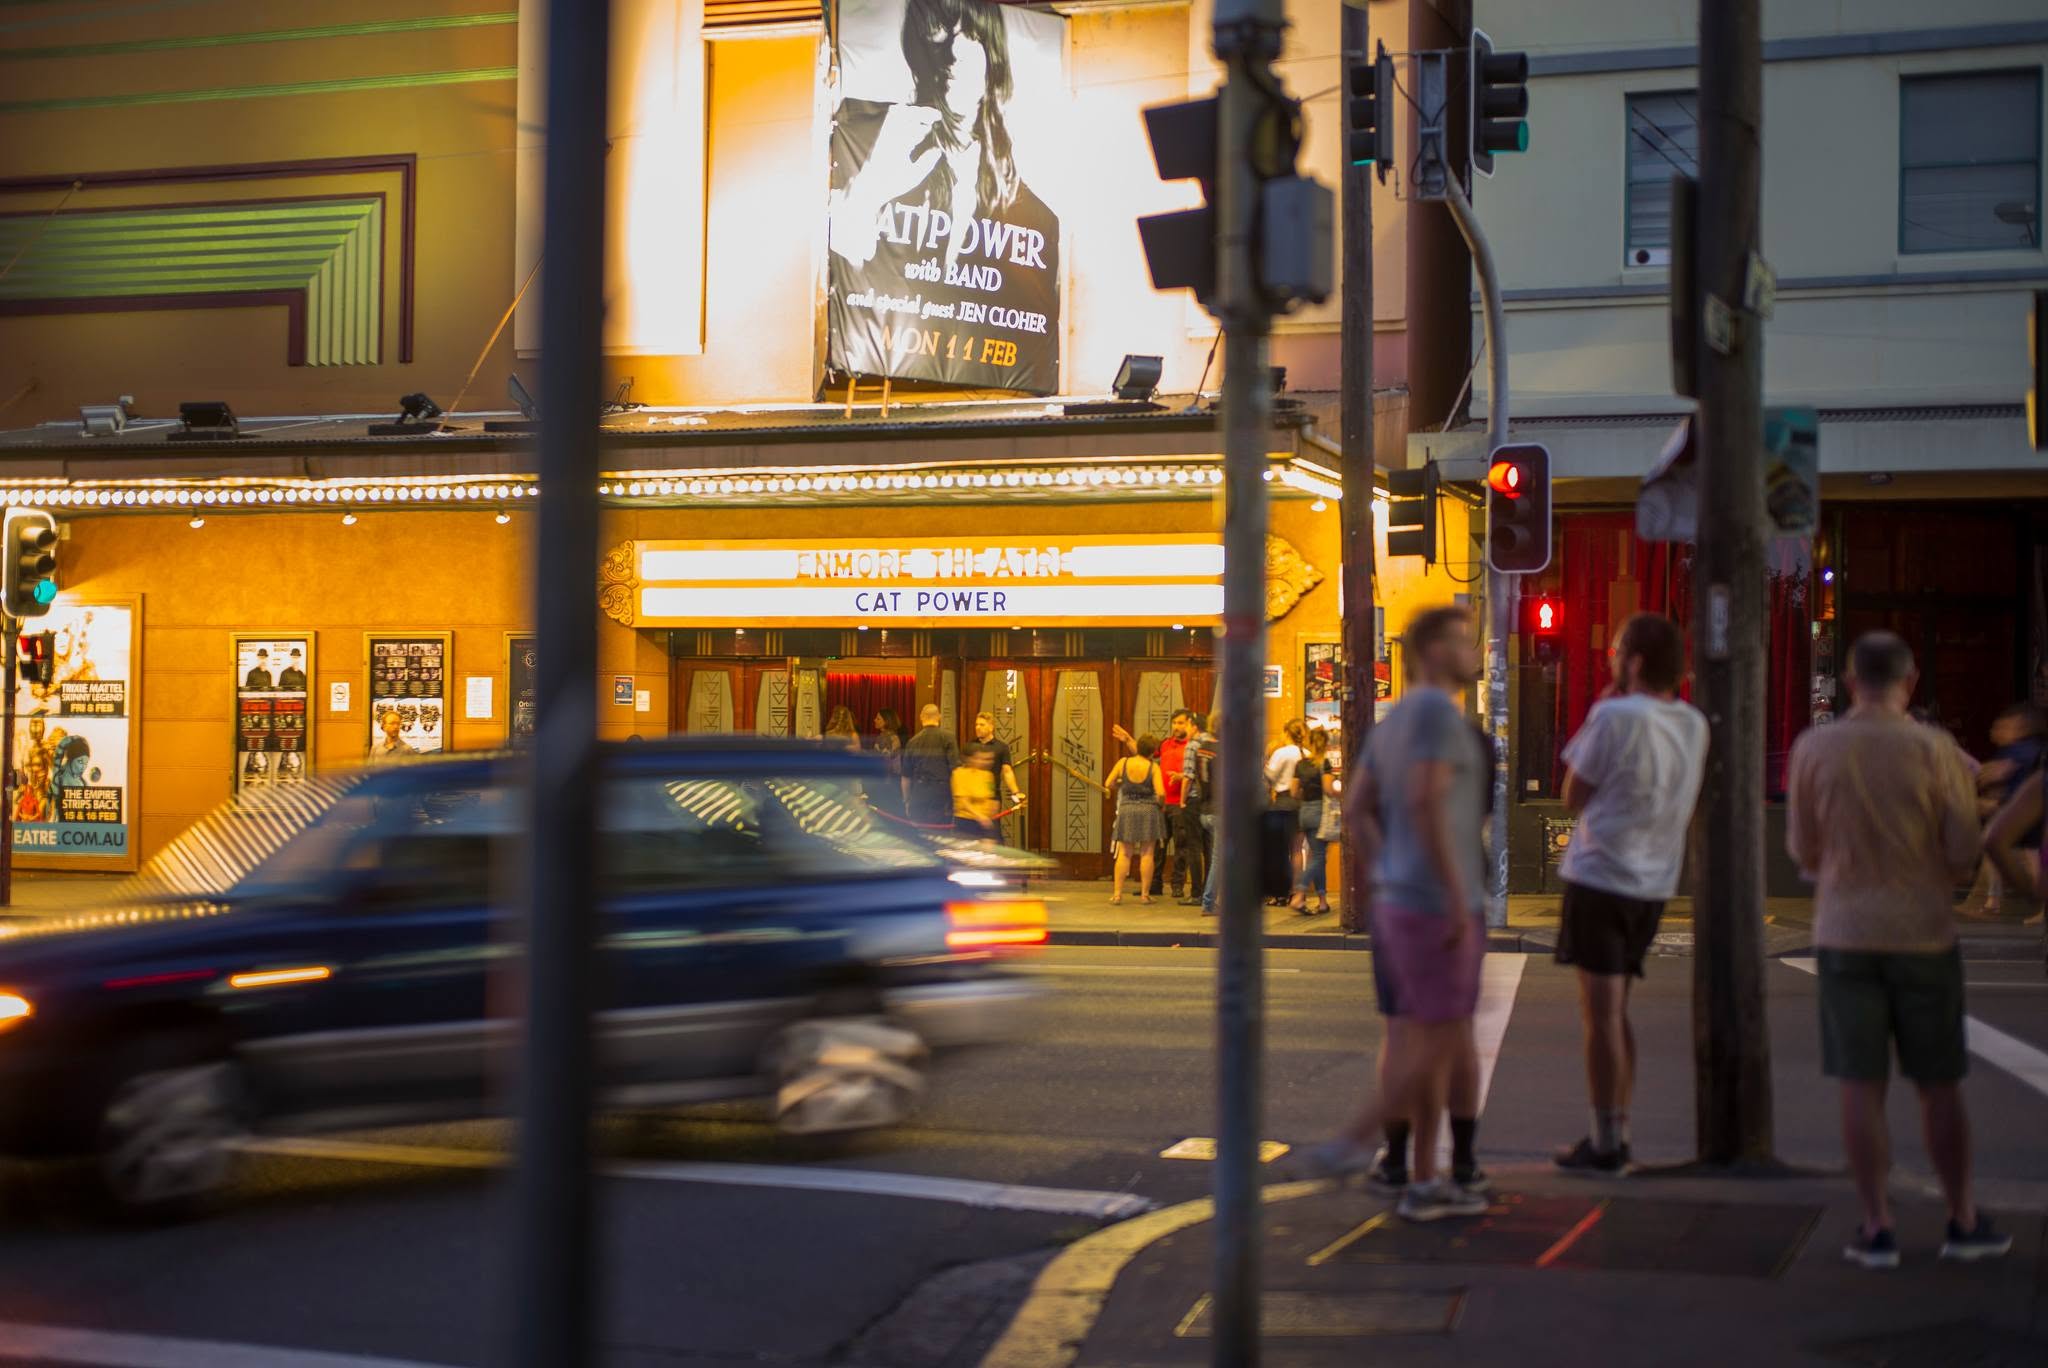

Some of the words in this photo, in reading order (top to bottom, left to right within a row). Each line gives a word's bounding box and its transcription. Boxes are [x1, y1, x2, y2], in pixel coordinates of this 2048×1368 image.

[904, 257, 941, 283] with
[944, 263, 1002, 292] BAND
[846, 288, 875, 307] and
[875, 294, 921, 314] special
[921, 301, 955, 320] guest
[956, 301, 986, 324] JEN
[988, 307, 1047, 334] CLOHER
[882, 325, 941, 357] MON
[980, 338, 1017, 367] FEB
[797, 551, 912, 578] ENMORE
[931, 548, 1073, 578] THEATRE
[855, 592, 901, 612] CAT
[918, 591, 1006, 612] POWER
[61, 683, 89, 693] TRIXIE
[89, 683, 124, 693] MATTEL
[61, 693, 91, 702] SKINNY
[63, 789, 83, 799] THE
[84, 789, 118, 799] EMPIRE
[62, 799, 92, 809] STRIPS
[93, 800, 119, 810] BACK
[98, 811, 117, 821] FEB
